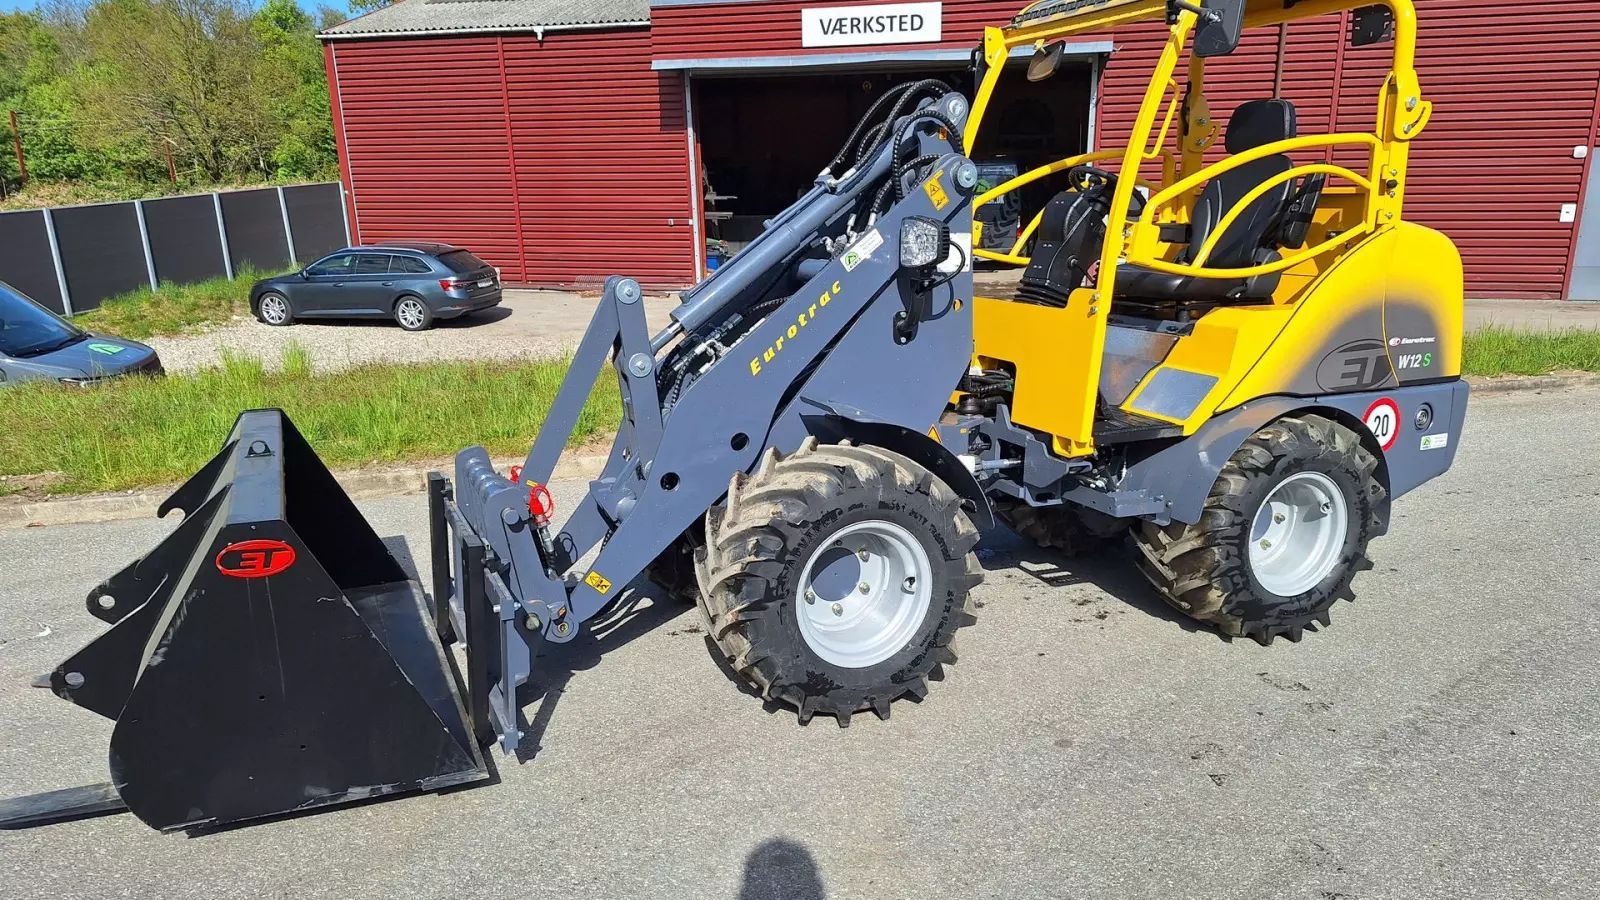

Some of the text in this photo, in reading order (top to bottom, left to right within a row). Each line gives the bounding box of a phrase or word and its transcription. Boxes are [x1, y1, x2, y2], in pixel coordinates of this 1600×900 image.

[819, 14, 924, 35] VÆRKSTED
[749, 280, 841, 376] Eurotrac
[1401, 336, 1436, 345] Eurotrac
[1319, 346, 1389, 389] ET
[1374, 414, 1389, 437] 20
[219, 545, 290, 573] ET
